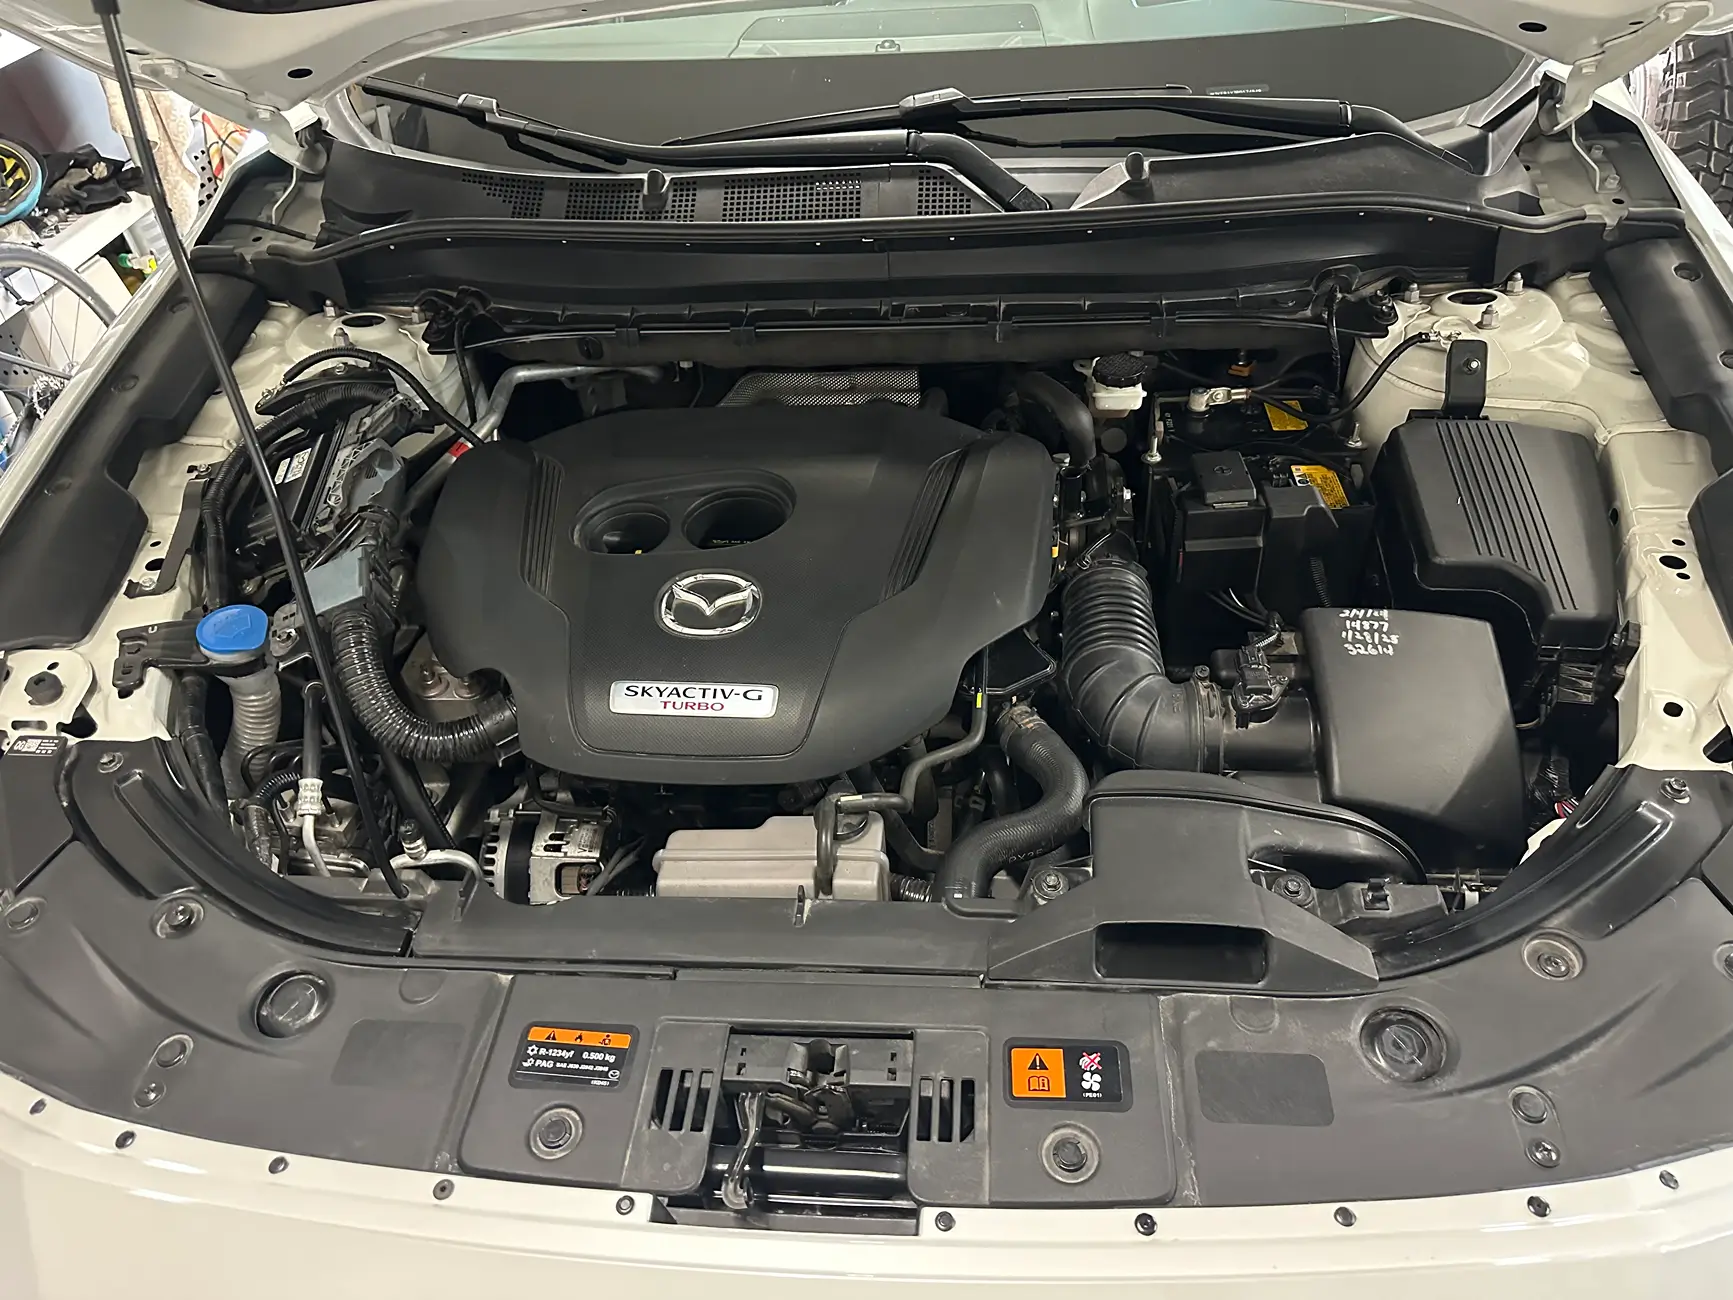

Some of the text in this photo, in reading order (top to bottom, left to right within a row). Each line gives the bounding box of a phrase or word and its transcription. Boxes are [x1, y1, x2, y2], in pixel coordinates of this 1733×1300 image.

[1346, 620, 1388, 632] 14877
[1344, 643, 1393, 656] 32614
[624, 685, 763, 701] SKYACTIV-G
[660, 701, 725, 712] TURBO
[539, 1047, 616, 1063] R-1234yf 0.500 kg
[535, 1059, 554, 1068] PAG
